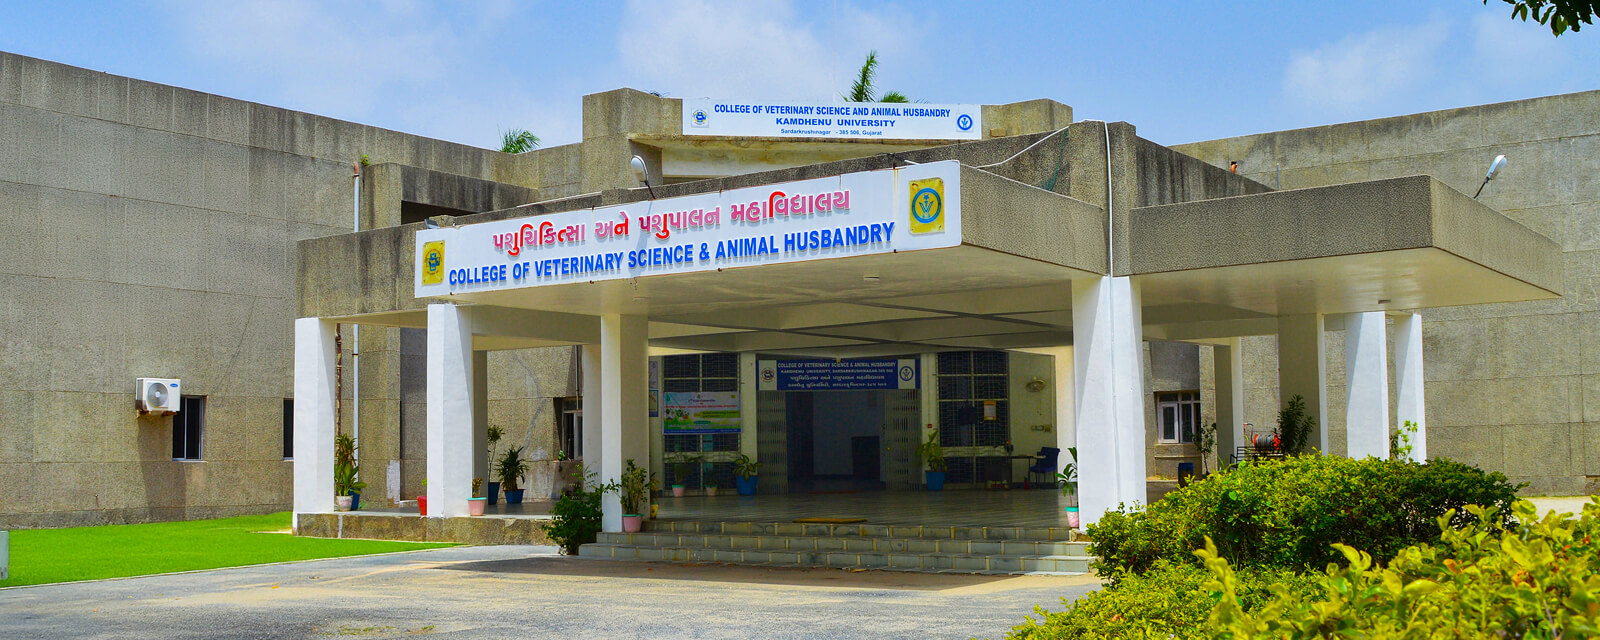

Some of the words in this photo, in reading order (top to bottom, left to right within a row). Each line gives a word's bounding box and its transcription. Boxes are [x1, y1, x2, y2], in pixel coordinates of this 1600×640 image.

[714, 104, 750, 114] COLLEGE
[752, 105, 763, 114] OF
[765, 105, 814, 116] VETERINARY
[816, 106, 850, 116] SCIENCE
[852, 107, 869, 117] AND
[871, 107, 901, 117] ANIMAL
[903, 108, 950, 118] HUSBANDRY
[776, 117, 832, 126] KAMDHENU
[837, 118, 896, 127] UNIVERSITY
[493, 221, 585, 256] પશુચિકિત્સા
[595, 212, 629, 238] અને
[639, 208, 720, 239] પશુપાલન
[731, 191, 850, 222] મહાવિદ્યાલય
[449, 264, 507, 285] COLLEGE
[513, 262, 530, 280] OF
[534, 252, 624, 277] VETERINARY
[628, 244, 693, 268] SCIENCE
[699, 243, 710, 261] &
[715, 235, 779, 259] ANIMAL
[784, 222, 895, 252] HUSBANDRY
